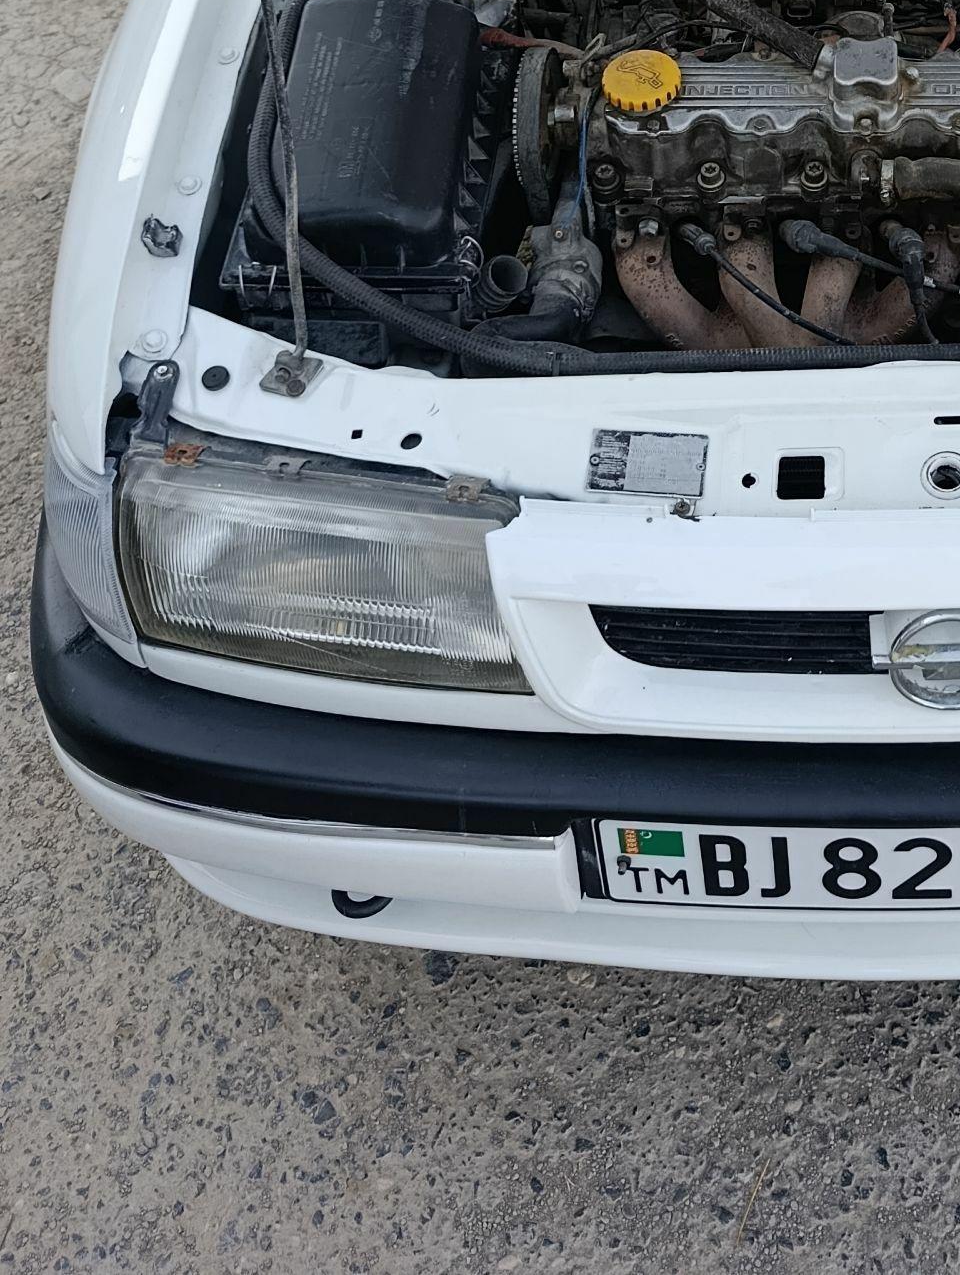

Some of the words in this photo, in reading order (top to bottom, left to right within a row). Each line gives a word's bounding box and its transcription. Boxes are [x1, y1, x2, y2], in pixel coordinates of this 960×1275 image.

[681, 84, 809, 96] INJECTION
[699, 833, 792, 898] BJ
[626, 867, 690, 896] TM
